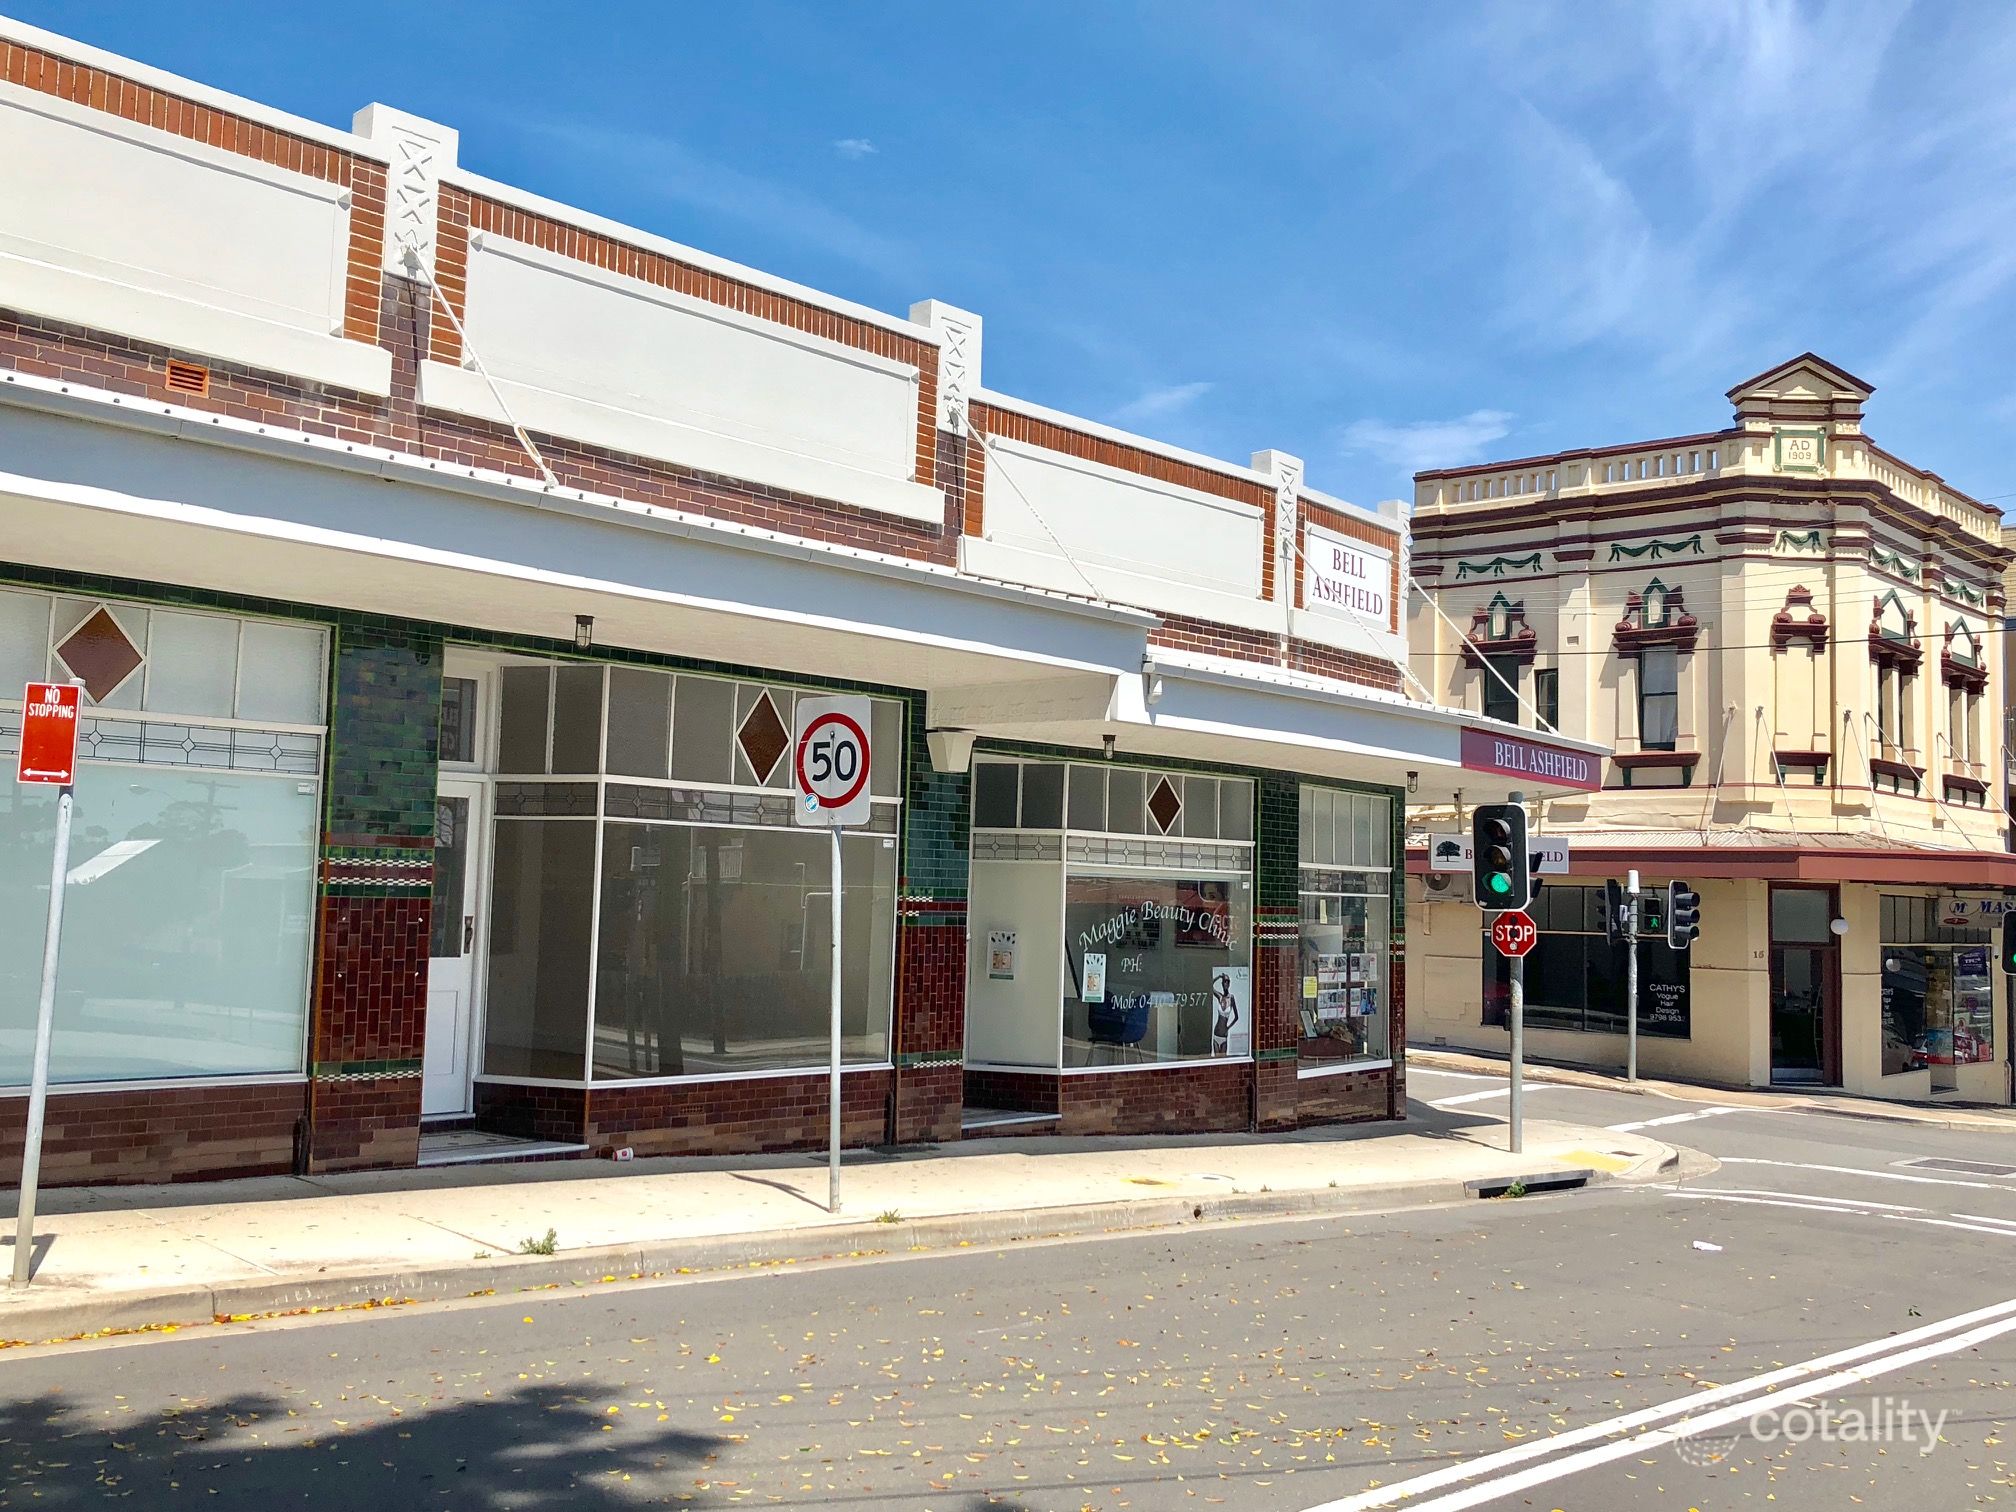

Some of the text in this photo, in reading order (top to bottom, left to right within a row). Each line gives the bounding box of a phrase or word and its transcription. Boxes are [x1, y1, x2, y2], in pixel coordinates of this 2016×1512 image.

[1790, 440, 1810, 451] AD
[1788, 451, 1812, 459] 1909
[1332, 548, 1367, 580] BELL
[1312, 579, 1384, 616] ASHFIELD
[45, 688, 61, 704] NO
[28, 703, 75, 718] STOPPING
[812, 740, 857, 782] 50
[1494, 741, 1588, 783] BELL ASHFIELD
[1079, 905, 1137, 953] Maggie
[1140, 900, 1195, 933] Beauty
[1198, 912, 1239, 952] Clinic
[1495, 925, 1534, 943] STOP
[1121, 953, 1143, 973] PH:
[1649, 983, 1686, 993] CATHY'S
[1656, 992, 1679, 1001] Vogue
[1111, 990, 1137, 1010] Mob:
[1189, 992, 1208, 1007] 577
[1655, 1006, 1680, 1015] Design
